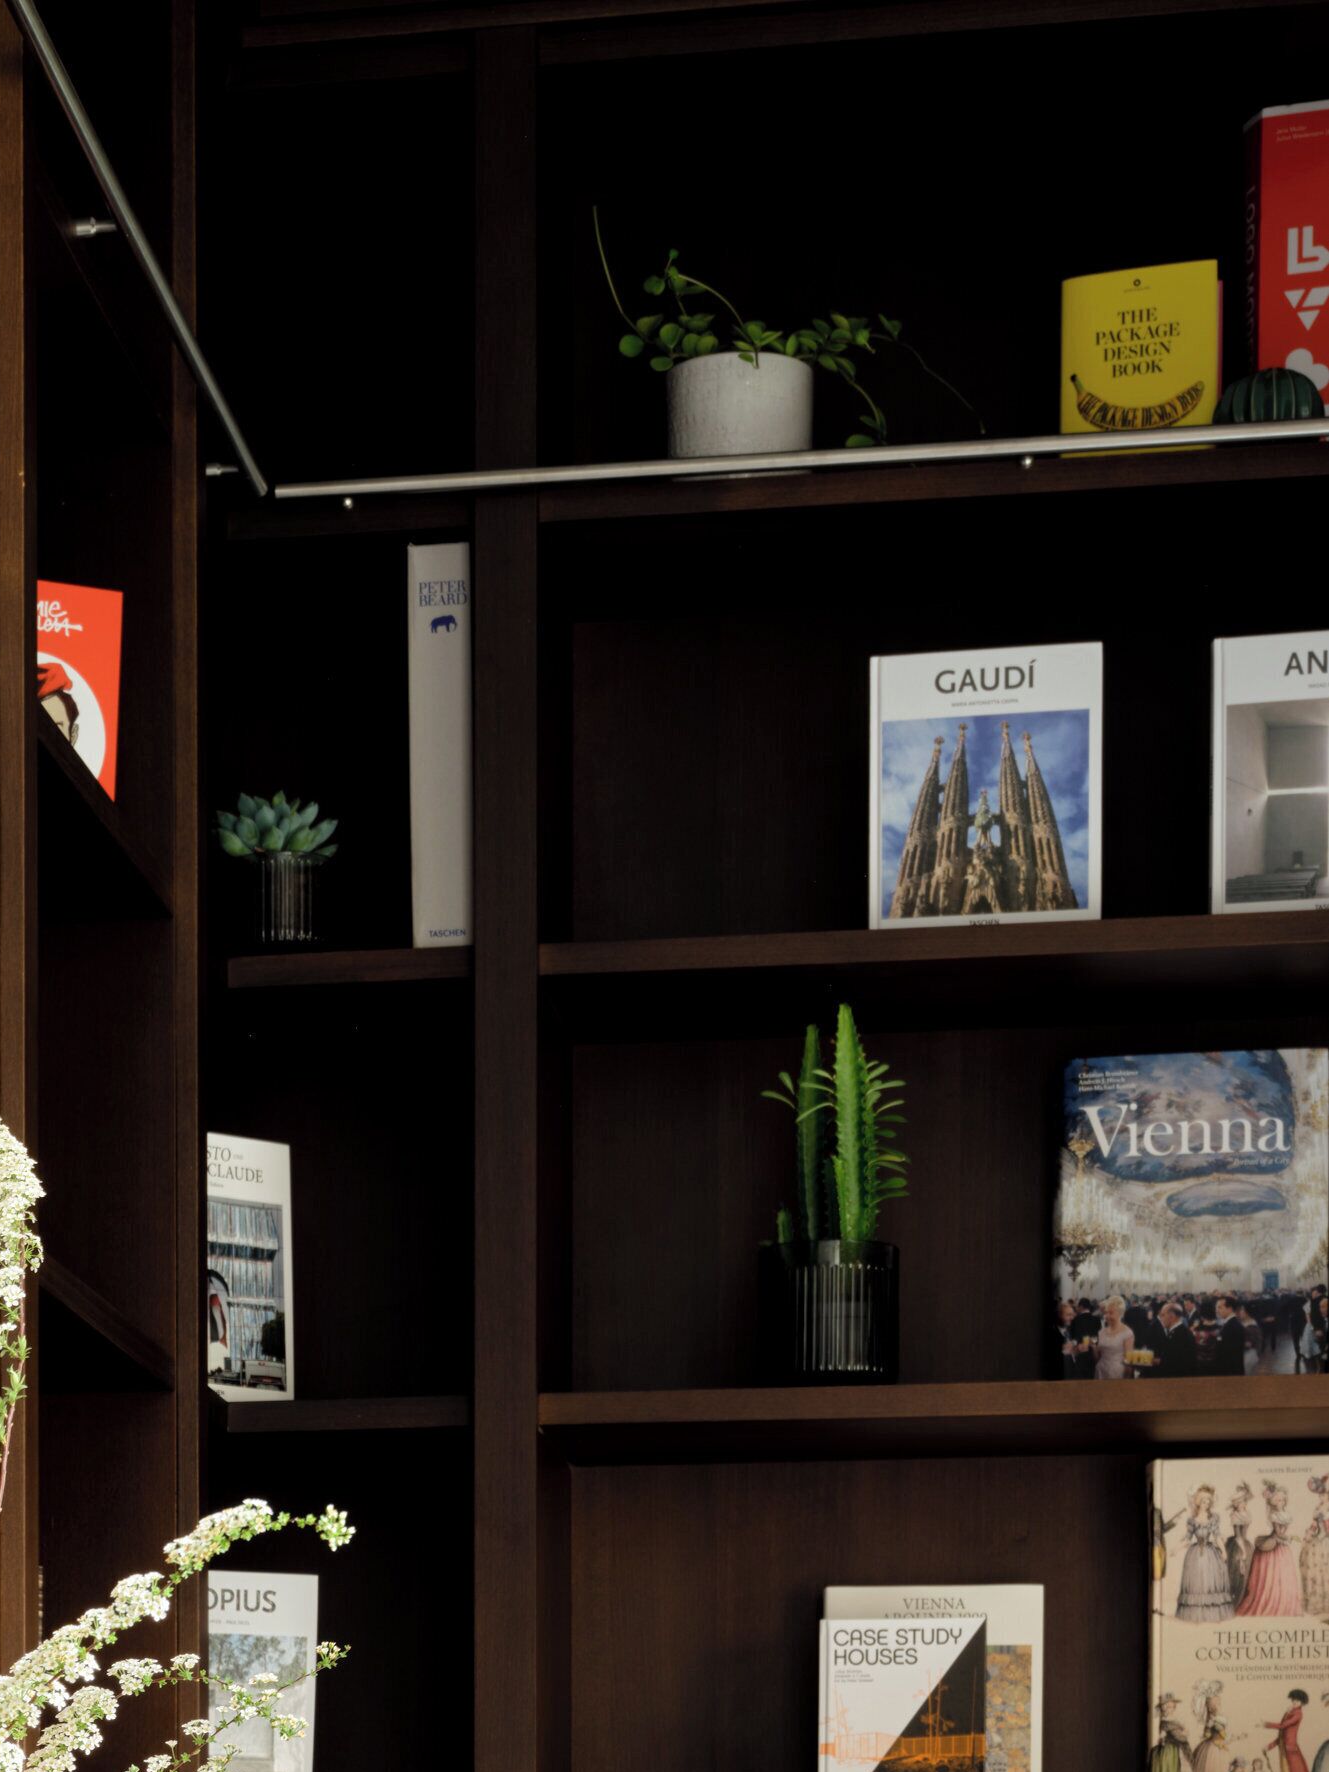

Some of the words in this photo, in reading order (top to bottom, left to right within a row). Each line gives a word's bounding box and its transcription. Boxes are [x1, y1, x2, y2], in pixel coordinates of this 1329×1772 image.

[1117, 307, 1158, 325] THE
[1095, 322, 1181, 346] PACKAGE
[1103, 341, 1172, 363] DESIGN
[1112, 358, 1164, 379] BOOK
[419, 580, 467, 593] PETER
[419, 593, 469, 607] BEARD
[934, 658, 1037, 694] GAUDÍ
[429, 929, 466, 938] TASCHEN
[1079, 1102, 1291, 1158] Vienna
[903, 1598, 965, 1610] VIENNA
[833, 1629, 889, 1647] CASE
[895, 1628, 962, 1645] STUDY
[1213, 1631, 1252, 1645] THE
[834, 1648, 918, 1666] HOUSES
[1195, 1646, 1286, 1661] COSTUME
